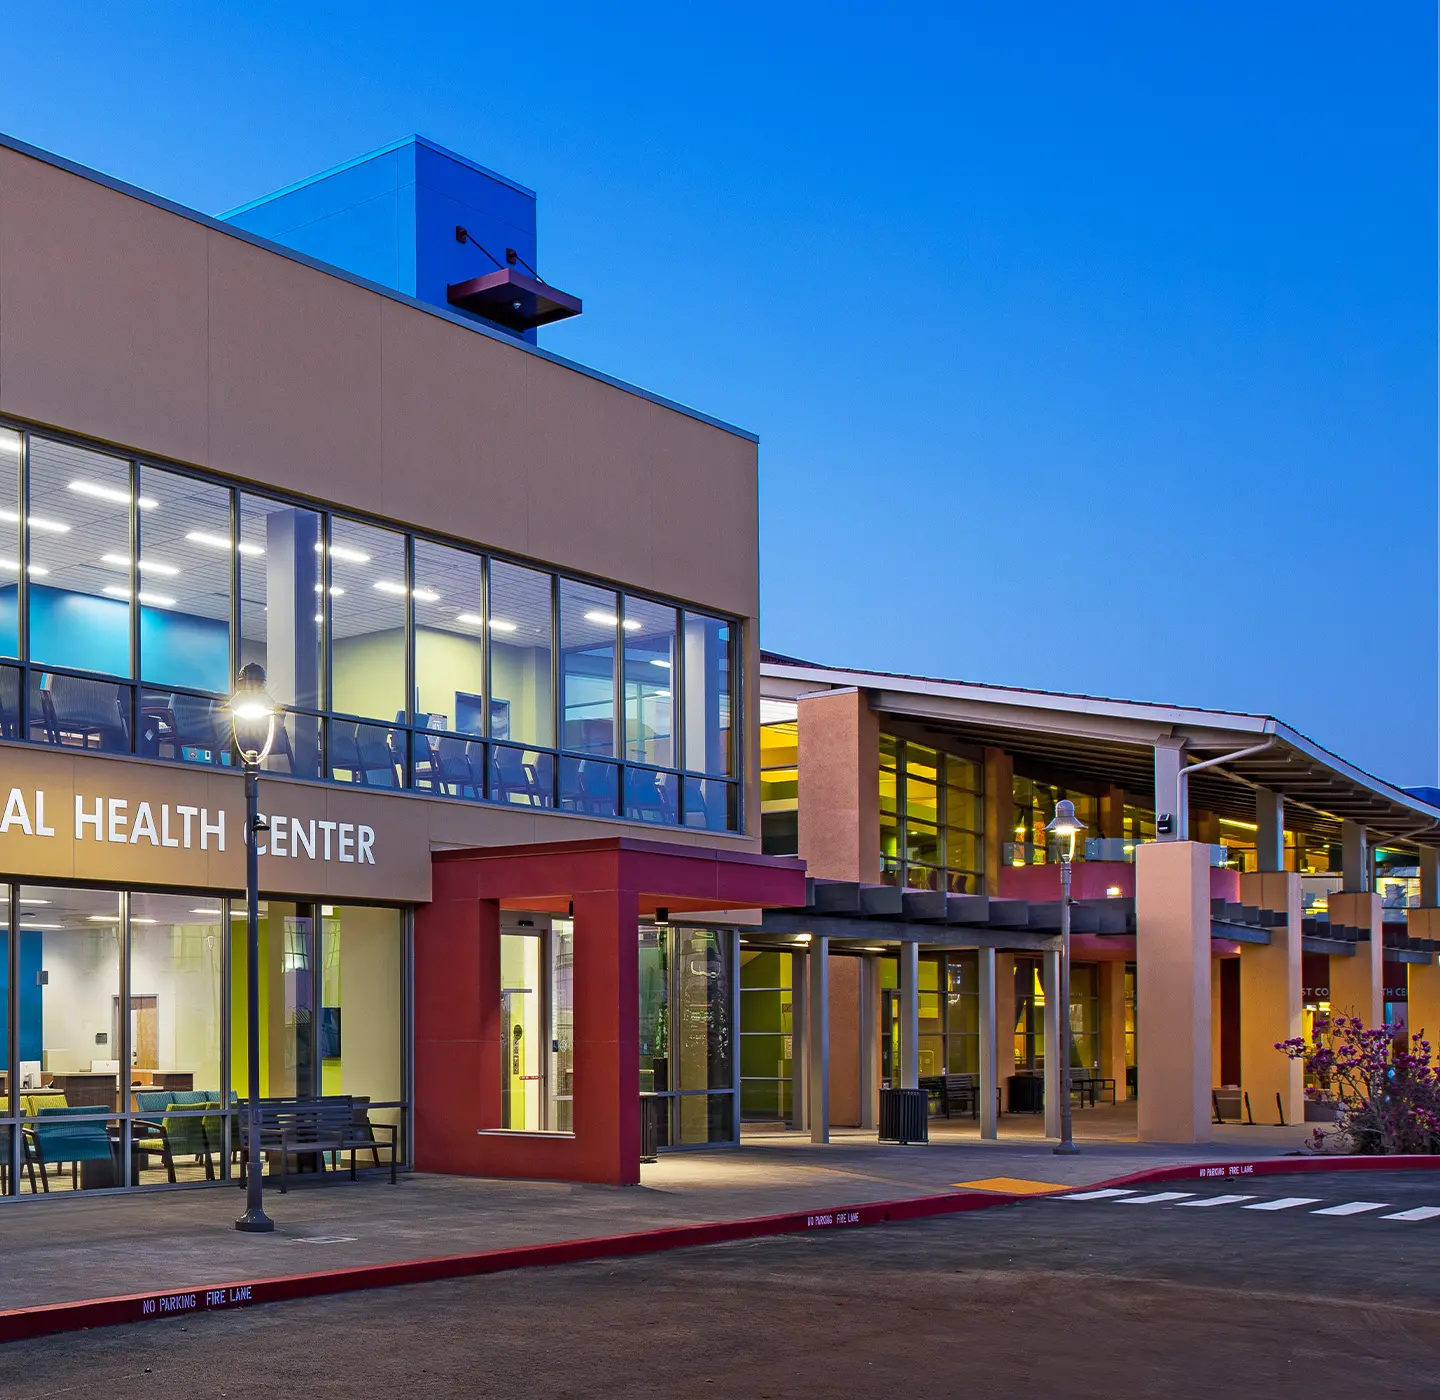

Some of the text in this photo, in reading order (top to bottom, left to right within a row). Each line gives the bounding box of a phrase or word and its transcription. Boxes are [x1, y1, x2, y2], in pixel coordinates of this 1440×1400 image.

[75, 794, 226, 851] HEALTH
[1207, 1168, 1224, 1176] PARKING
[1229, 1166, 1240, 1175] FIRE
[1241, 1165, 1253, 1174] LANE
[815, 1215, 832, 1225] PARKING
[836, 1213, 847, 1224] FIRE
[143, 1286, 253, 1314] NO PARKING FIRE LANE
